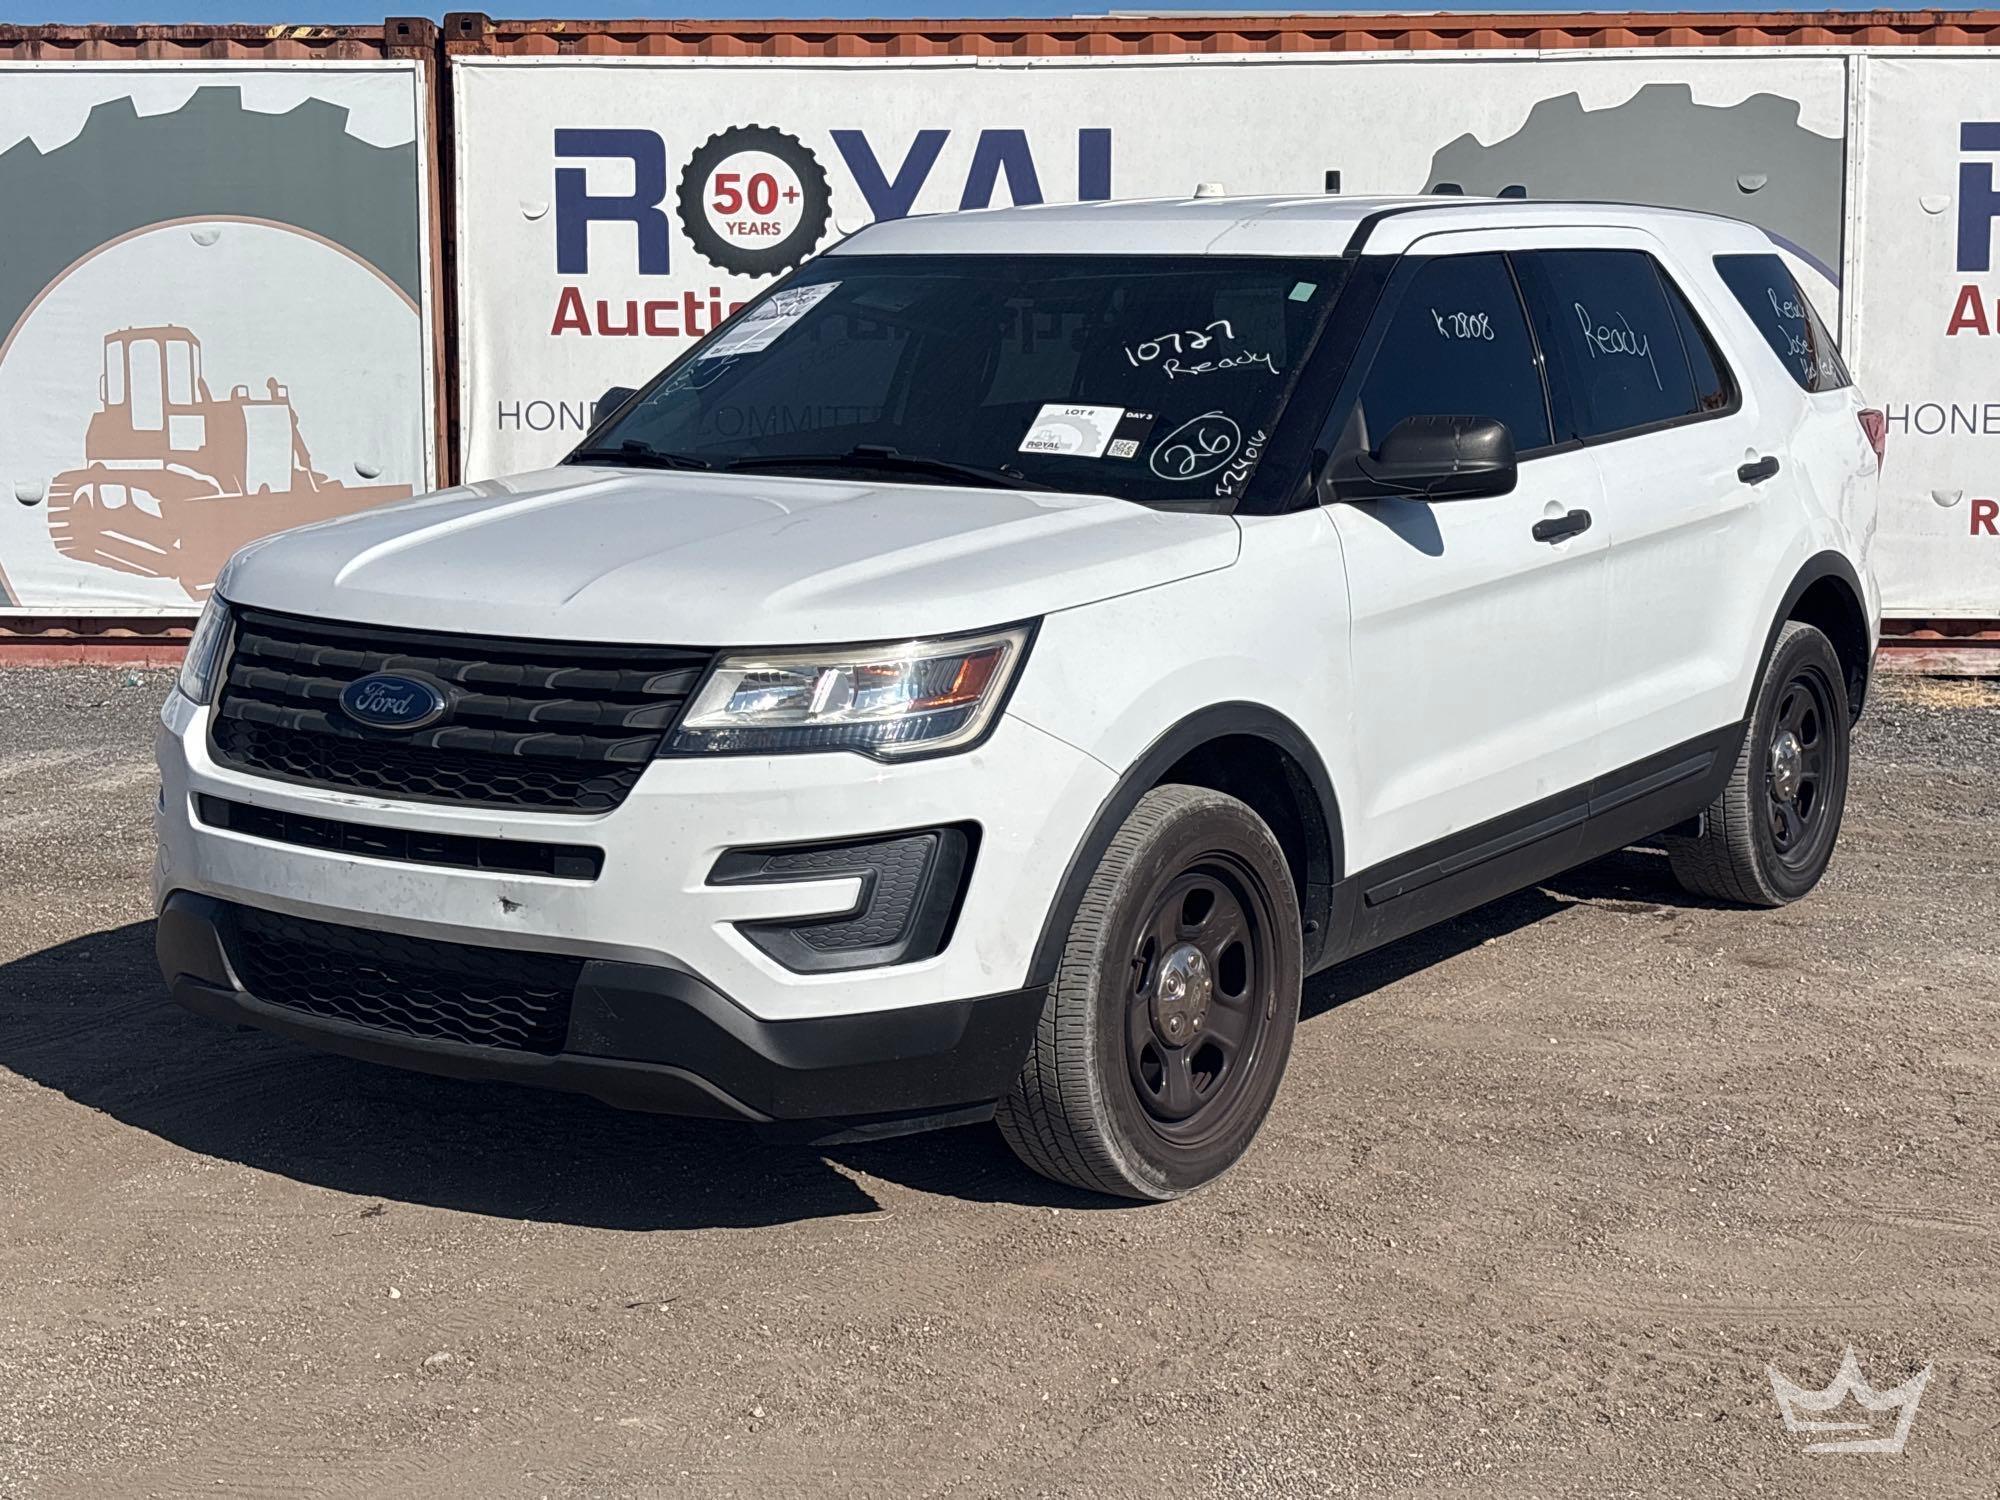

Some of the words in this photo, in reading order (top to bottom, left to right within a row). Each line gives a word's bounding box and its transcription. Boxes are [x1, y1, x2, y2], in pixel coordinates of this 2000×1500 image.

[712, 173, 800, 215] 50+
[725, 221, 782, 236] YEARS
[551, 286, 748, 337] Aucti
[1125, 320, 1235, 367] 10727
[1163, 350, 1279, 379] Ready
[1575, 302, 1662, 391] Ready
[1164, 427, 1230, 475] 26
[355, 681, 415, 714] Ford
